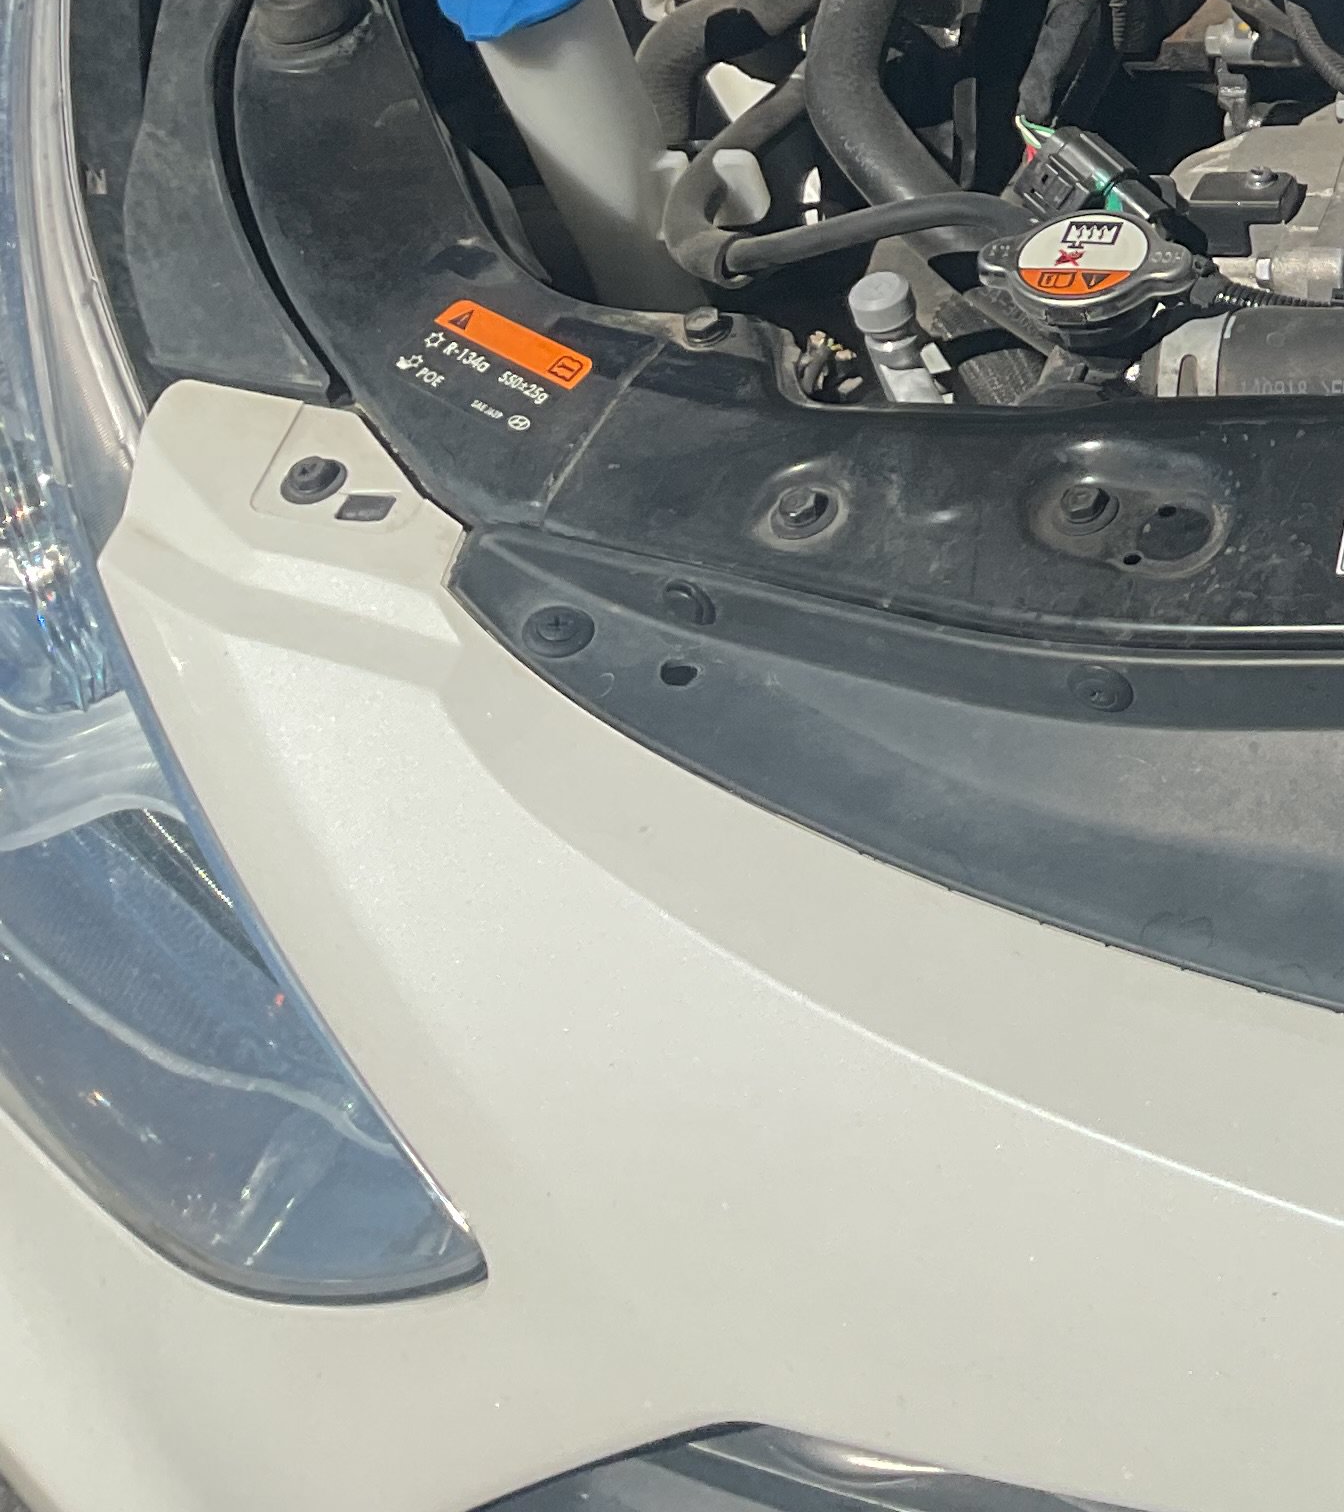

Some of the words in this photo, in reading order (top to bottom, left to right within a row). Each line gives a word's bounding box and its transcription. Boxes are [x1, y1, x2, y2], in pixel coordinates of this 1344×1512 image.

[415, 367, 445, 388] POE
[443, 341, 491, 373] R-134a
[498, 370, 549, 405] 550±25g
